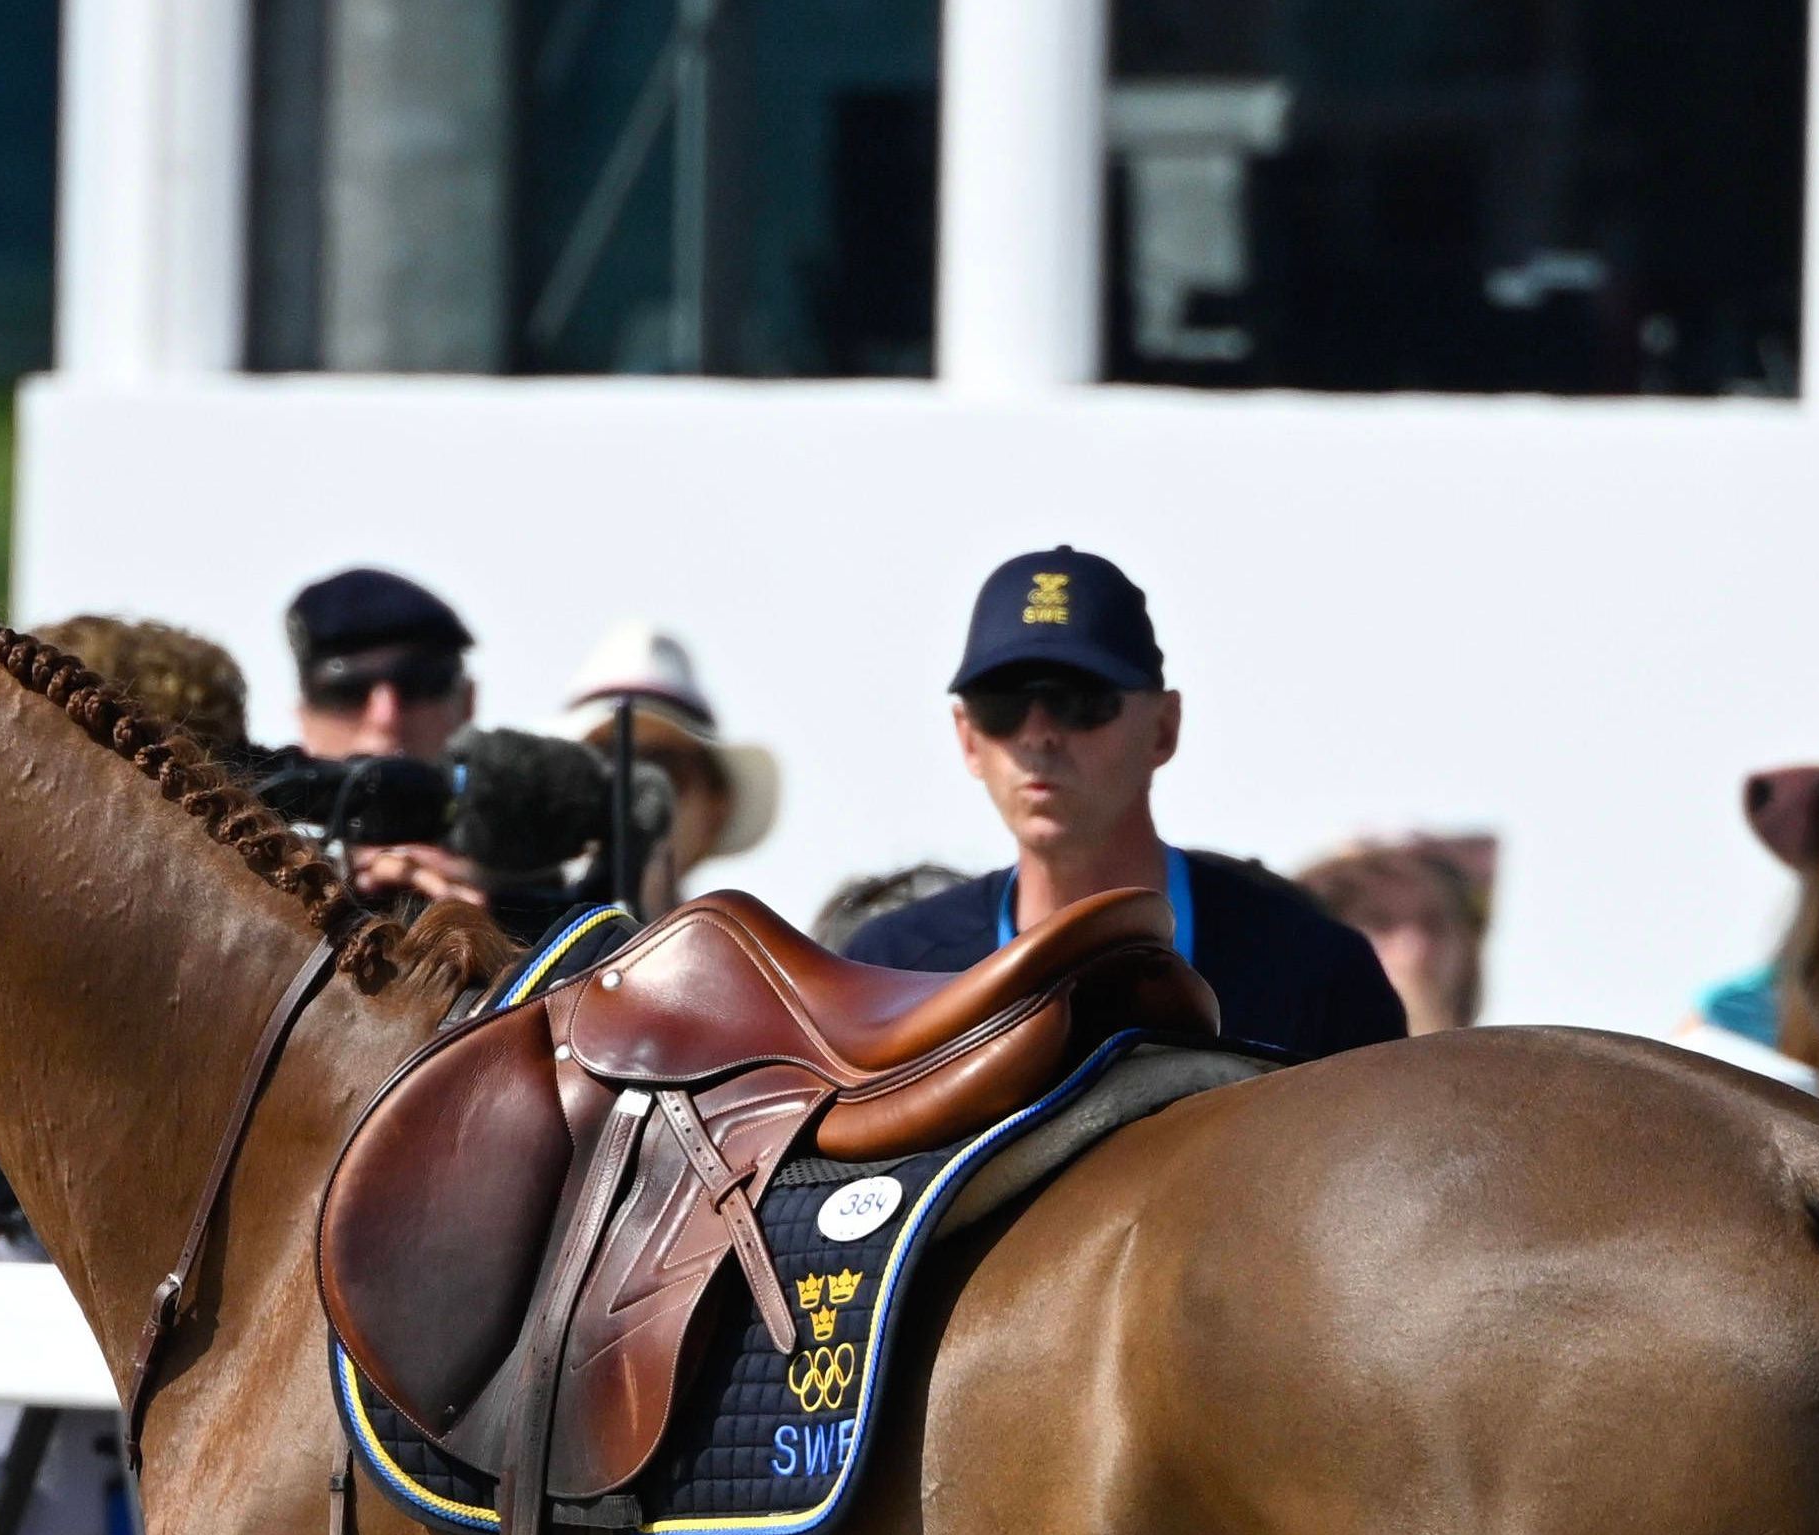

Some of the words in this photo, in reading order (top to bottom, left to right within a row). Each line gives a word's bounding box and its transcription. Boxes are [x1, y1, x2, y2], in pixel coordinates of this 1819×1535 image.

[1022, 605, 1070, 625] SWE
[839, 1190, 888, 1216] 384
[771, 1418, 855, 1476] SWE
